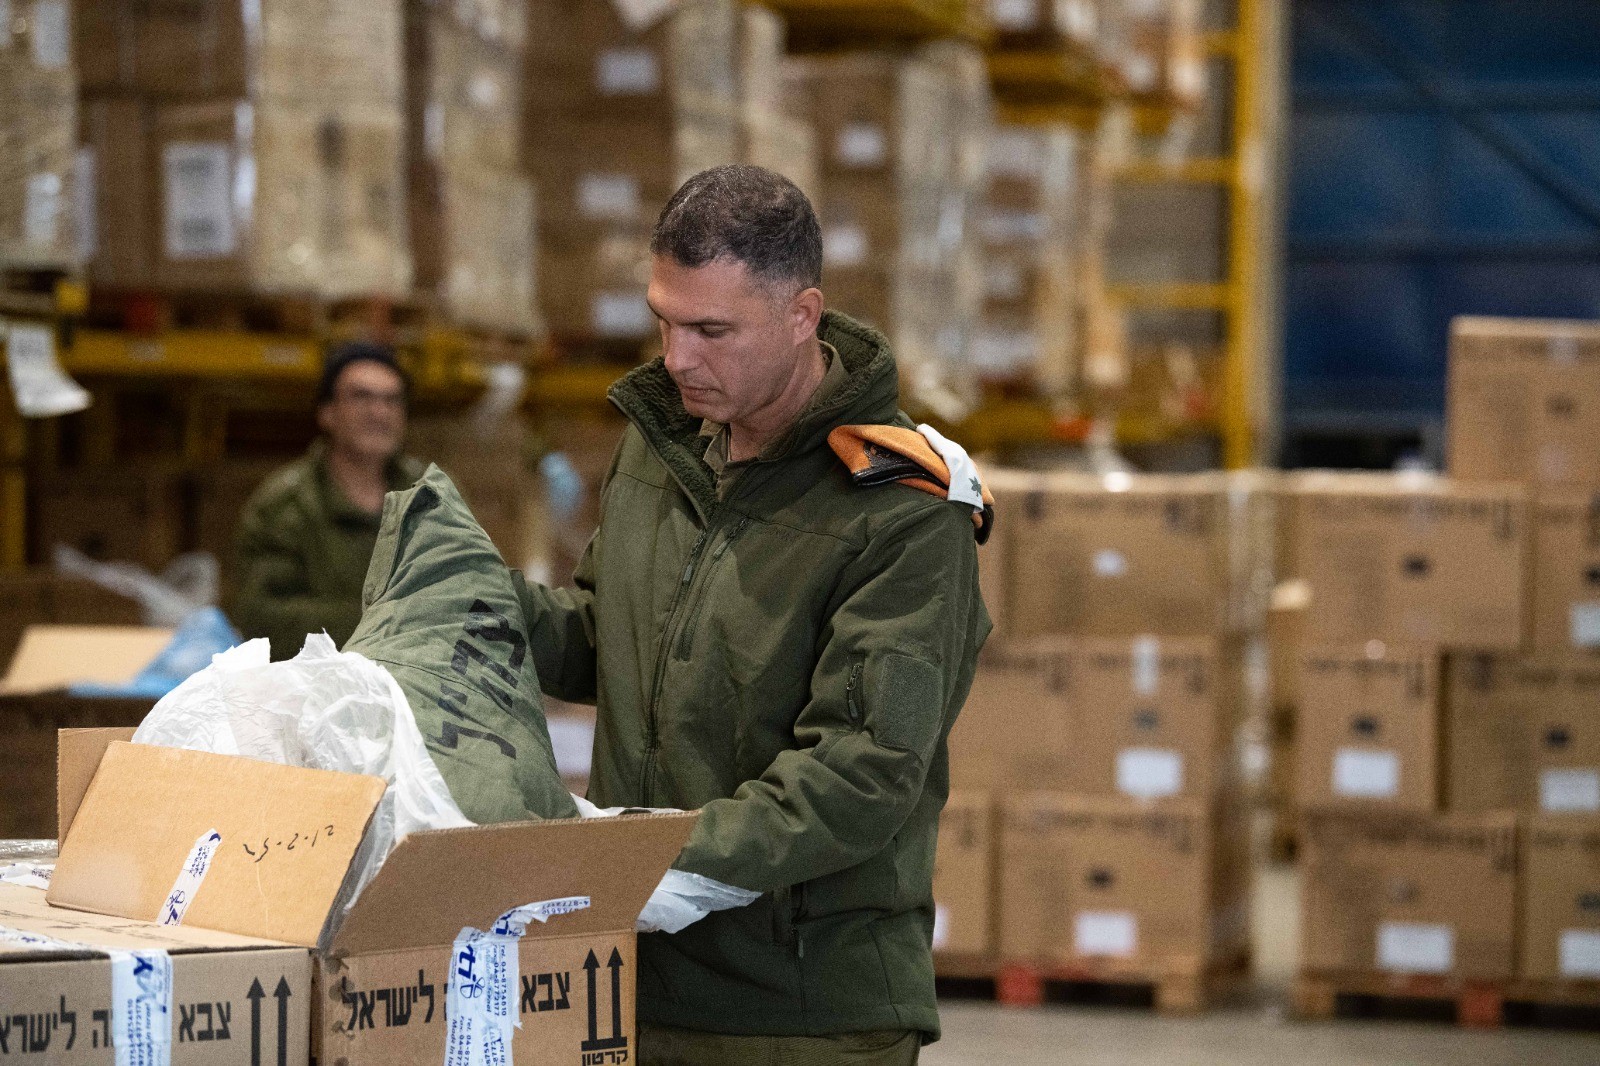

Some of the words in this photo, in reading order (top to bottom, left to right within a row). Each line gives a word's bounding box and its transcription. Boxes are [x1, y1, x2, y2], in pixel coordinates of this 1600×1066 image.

[341, 969, 434, 1031] לישראל
[521, 971, 571, 1014] צבא
[179, 1001, 231, 1043] צבא
[582, 1050, 628, 1066] קרטון
